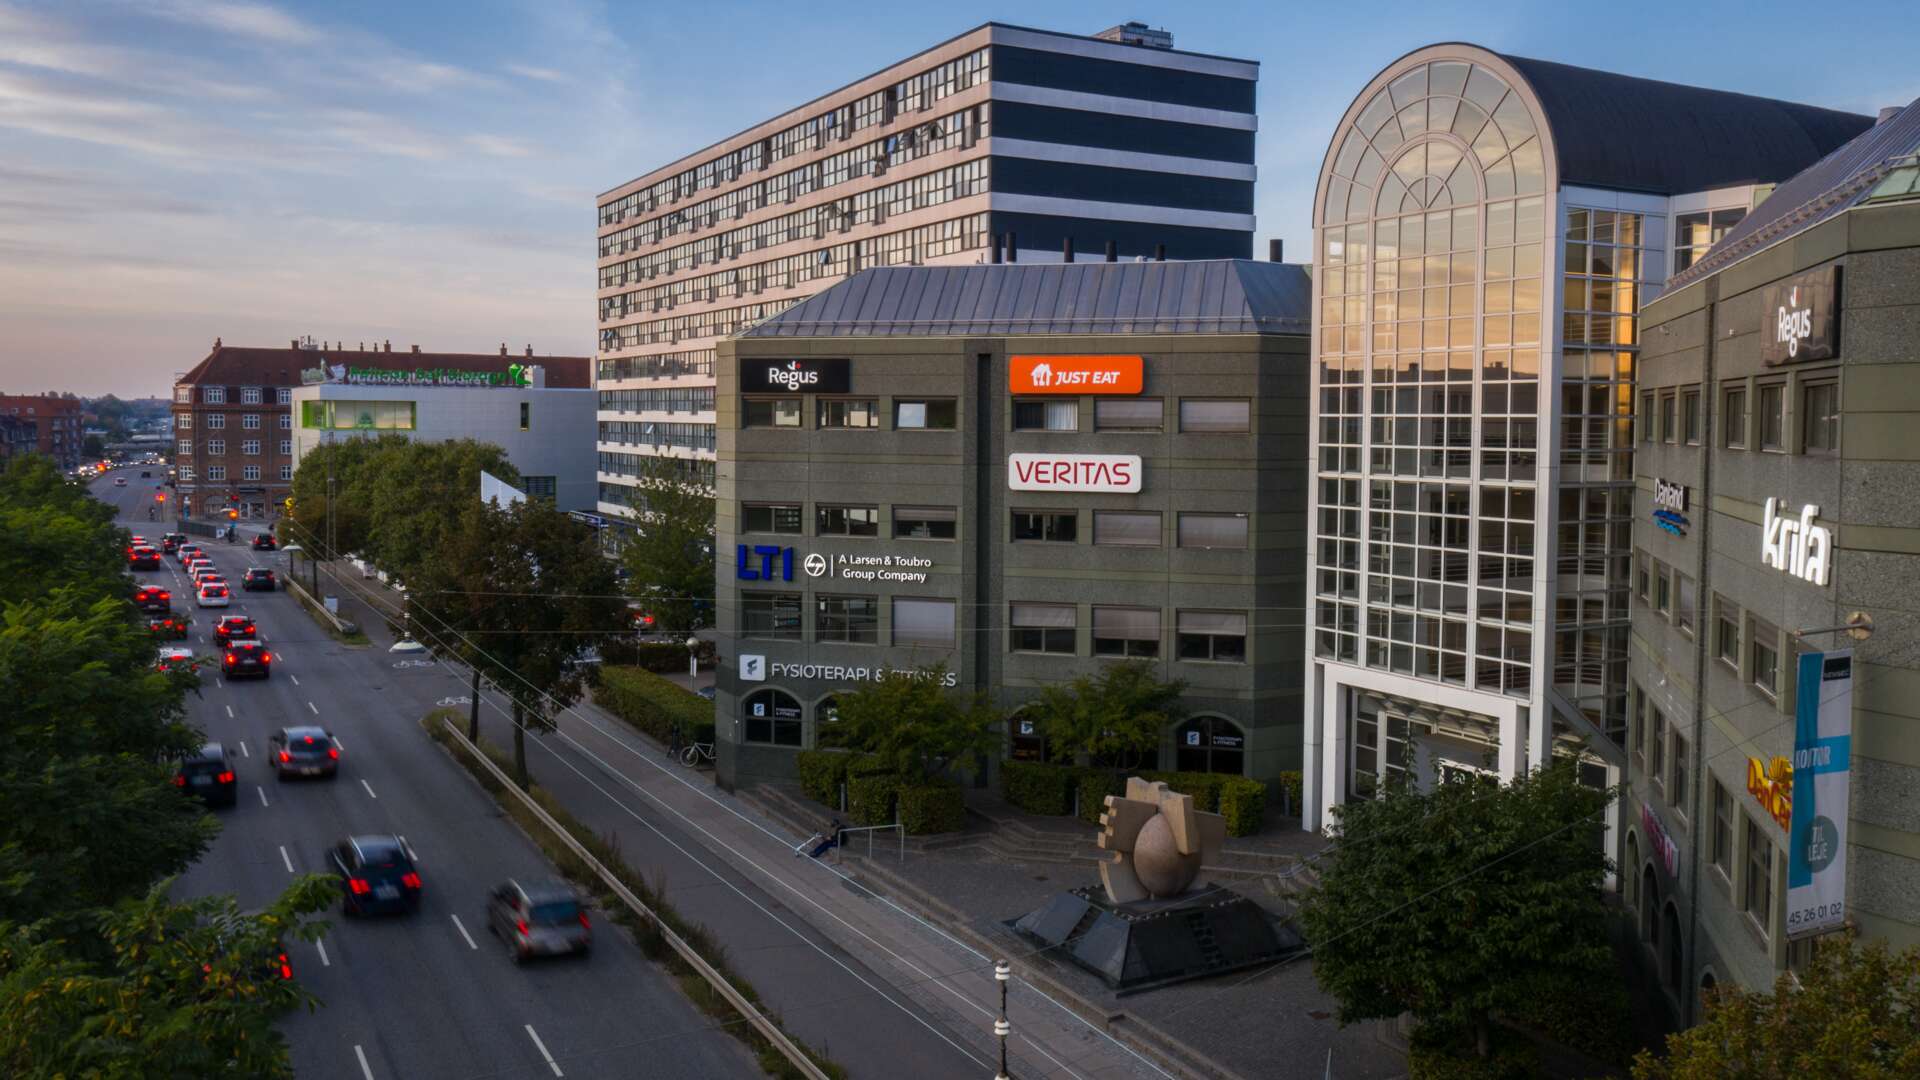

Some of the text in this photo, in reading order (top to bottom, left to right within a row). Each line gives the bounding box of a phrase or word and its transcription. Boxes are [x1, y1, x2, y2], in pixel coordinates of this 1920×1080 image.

[1777, 306, 1811, 358] Regus
[768, 367, 818, 391] Regus
[1055, 371, 1120, 385] JUST EAT
[1015, 460, 1131, 485] VERITAS
[1655, 478, 1684, 510] Danland
[1762, 497, 1832, 586] krifa
[738, 544, 793, 582] LTI
[838, 554, 931, 567] A Larsen & Toubro
[842, 568, 926, 583] Group Company
[771, 663, 870, 681] FYSIOTERAPI
[1789, 902, 1842, 925] 45 26 01 02
